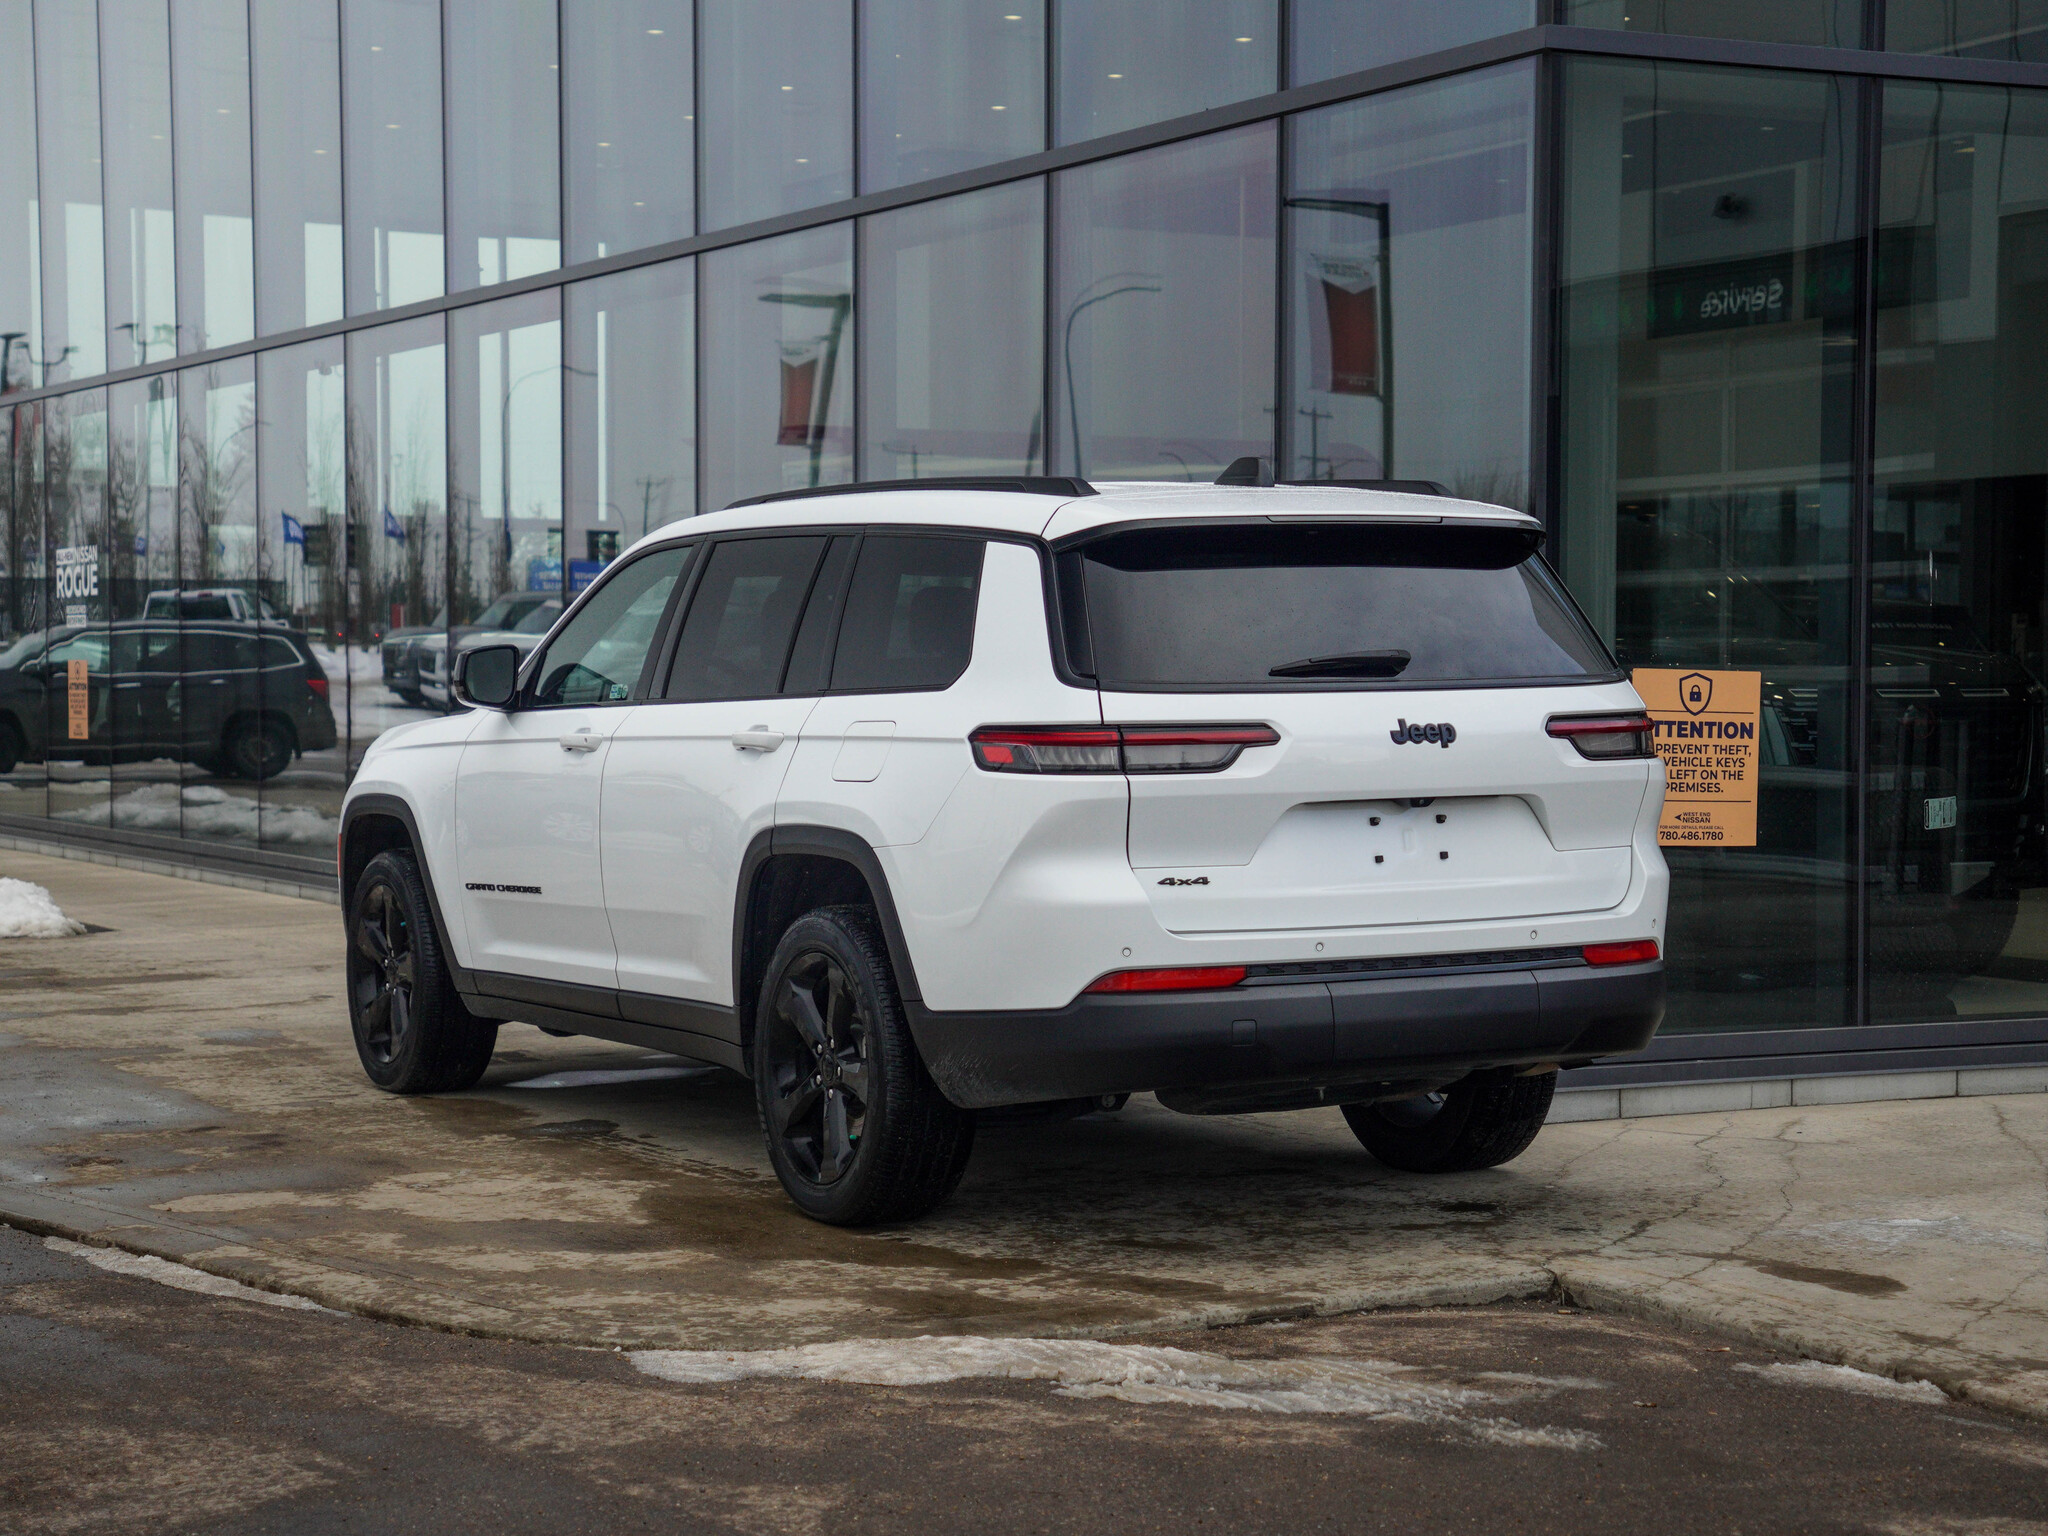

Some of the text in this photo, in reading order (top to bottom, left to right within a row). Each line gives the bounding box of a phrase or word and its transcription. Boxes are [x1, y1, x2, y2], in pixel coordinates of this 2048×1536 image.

[75, 545, 98, 564] NISSAN
[56, 564, 98, 599] ROGUE
[1389, 718, 1457, 749] Jeep
[1654, 720, 1754, 740] TTENTION
[1655, 743, 1752, 758] PREVENT THEFT,
[1663, 756, 1746, 769] VEHICLE KEYS
[1669, 769, 1744, 781] LEFT ON THE
[1660, 831, 1724, 841] 780.486.1780
[1157, 876, 1211, 886] 4x4
[465, 883, 542, 894] GRAND CHEROKEE
